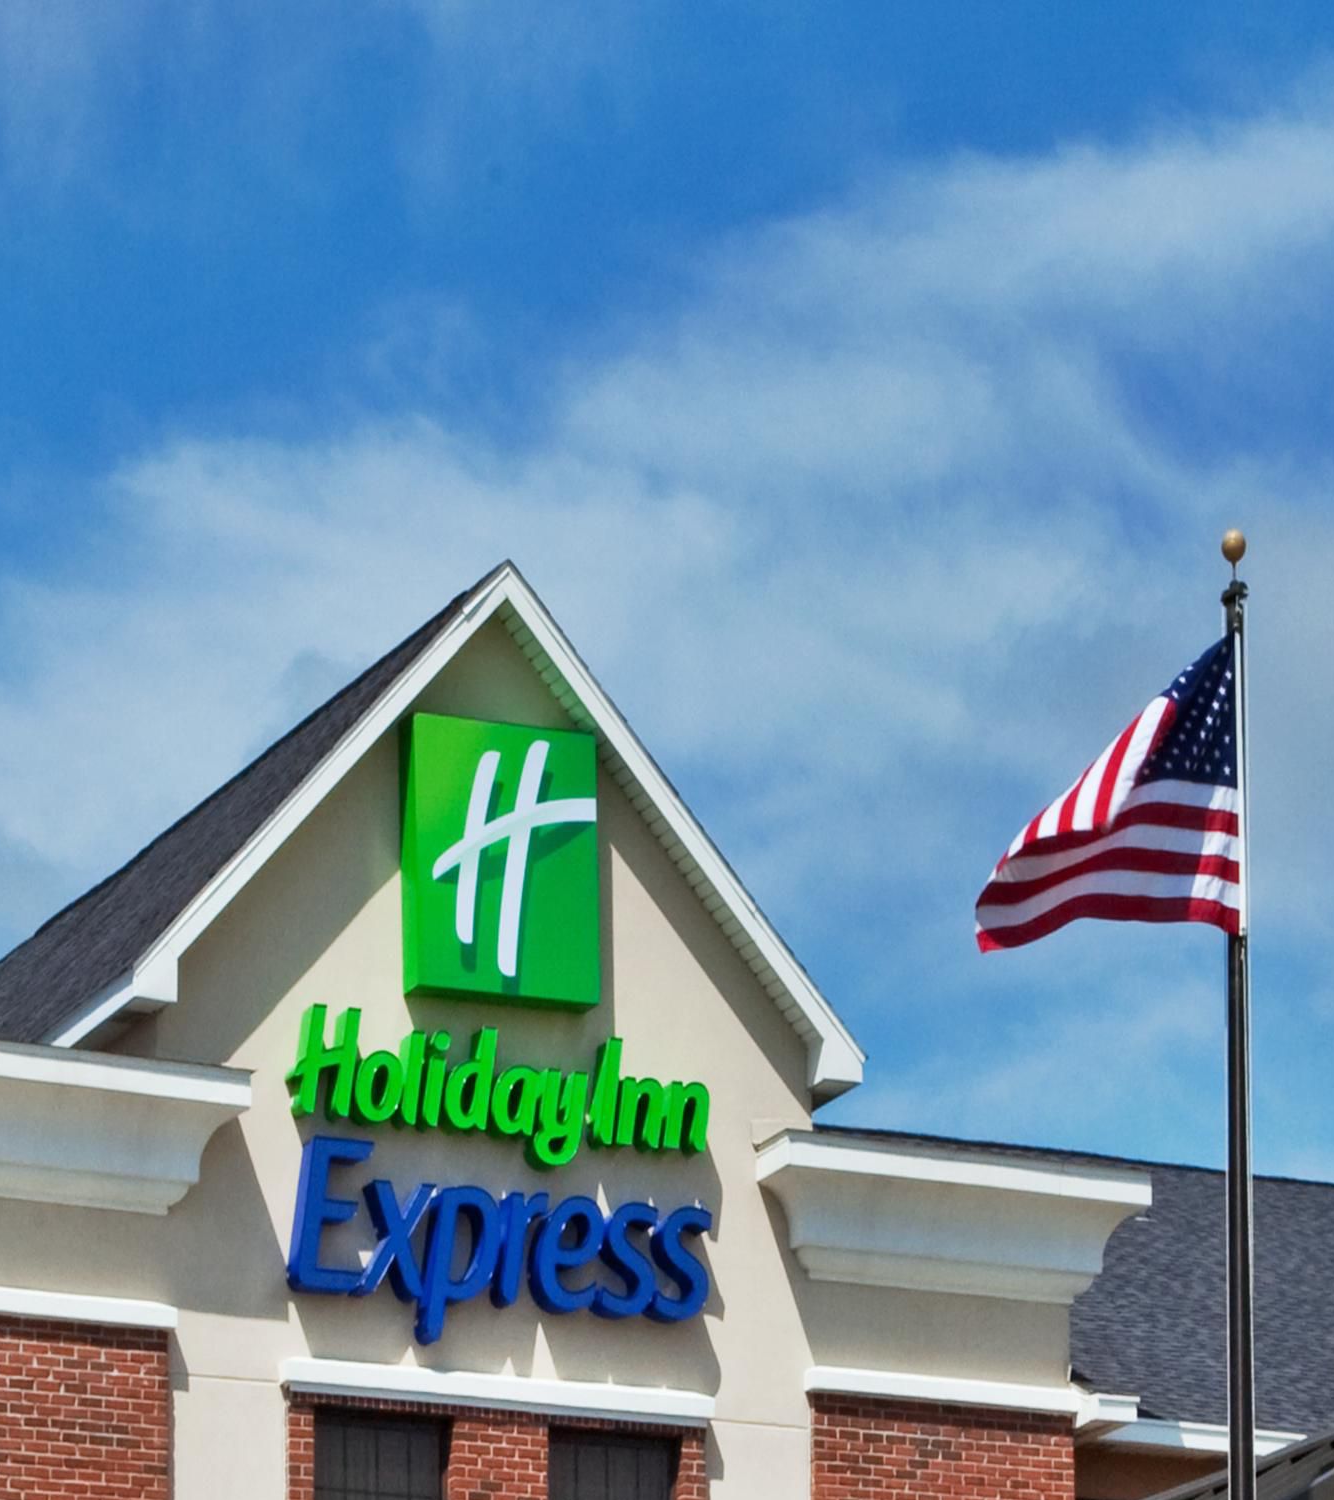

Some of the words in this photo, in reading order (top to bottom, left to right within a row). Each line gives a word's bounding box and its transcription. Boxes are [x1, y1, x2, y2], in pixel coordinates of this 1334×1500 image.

[286, 1003, 587, 1168] Holiday
[587, 1038, 710, 1153] Inn
[287, 1136, 712, 1345] Express
